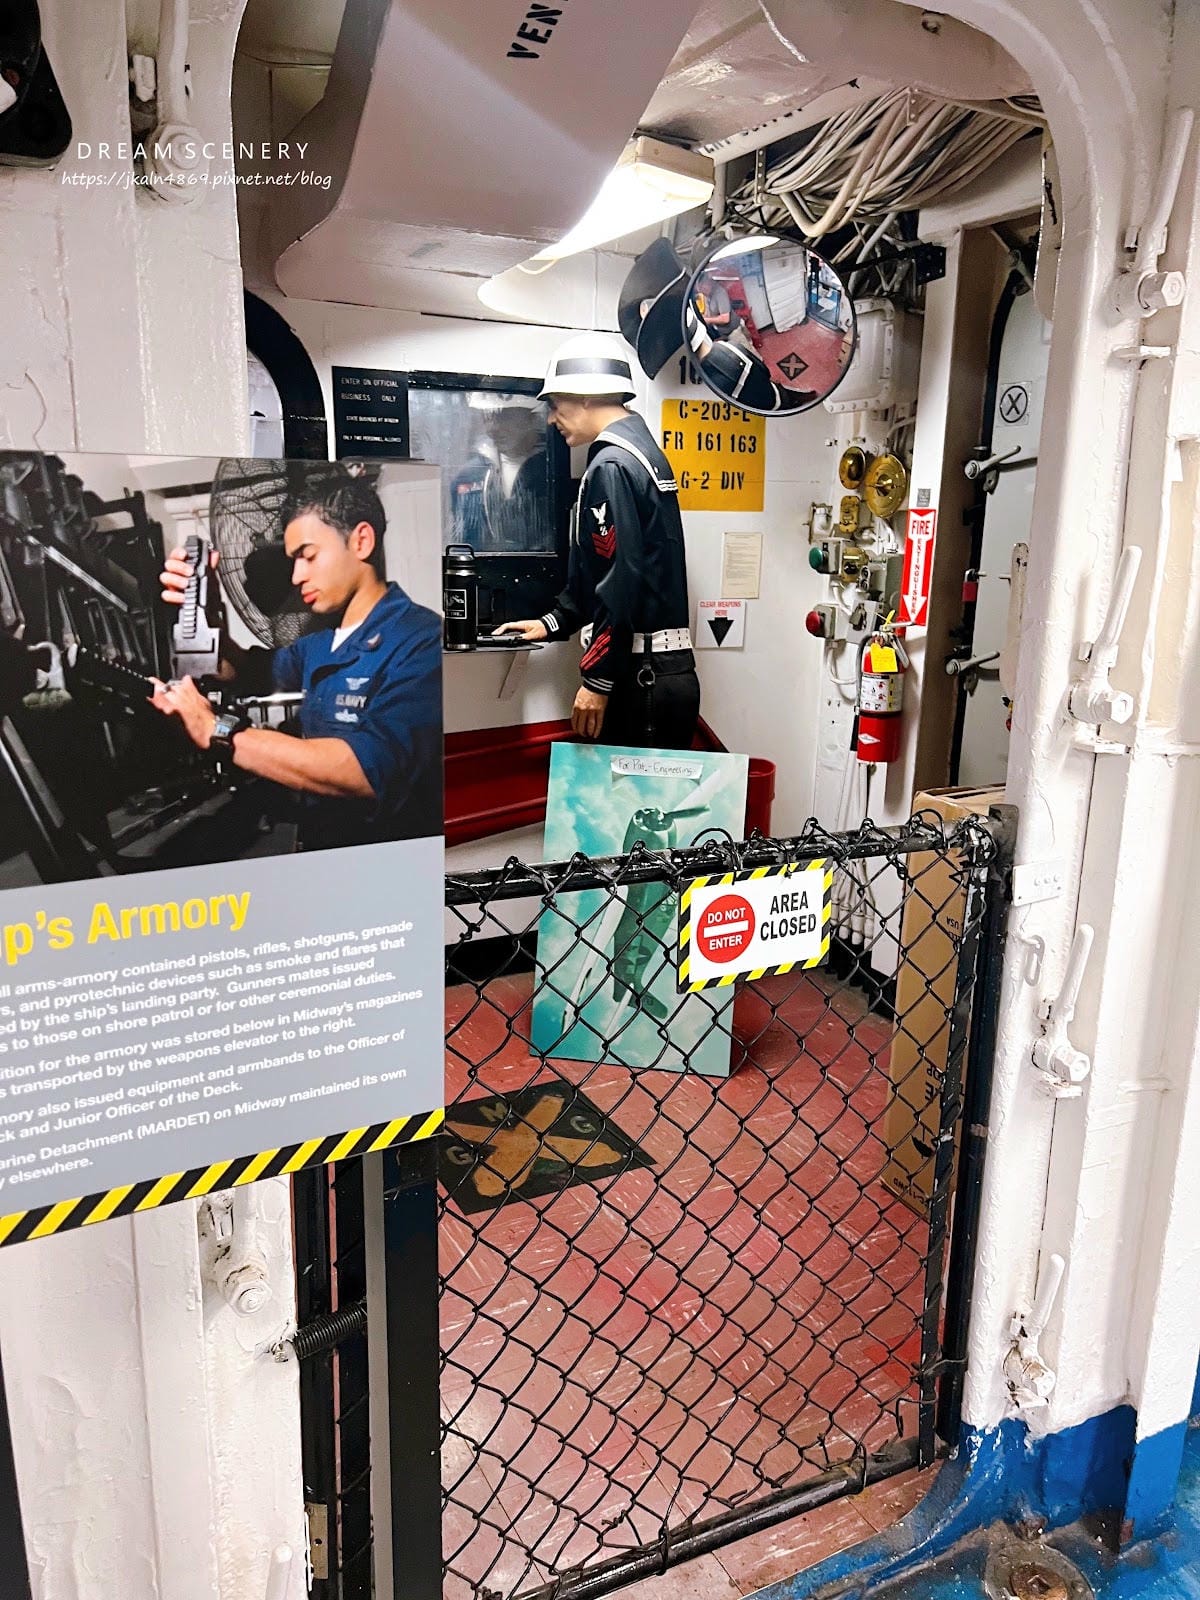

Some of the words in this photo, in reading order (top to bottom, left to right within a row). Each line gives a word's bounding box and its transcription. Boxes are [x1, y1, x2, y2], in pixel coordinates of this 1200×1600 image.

[506, 0, 569, 58] VEN
[663, 430, 684, 450] FR
[697, 431, 721, 452] 161
[730, 433, 757, 454] 163
[681, 471, 710, 490] G-2
[721, 471, 745, 490] DIV
[911, 520, 931, 536] FIRE
[0, 910, 74, 966] p's
[87, 891, 251, 945] Armory
[707, 911, 723, 924] DO
[725, 907, 747, 920] NOT
[760, 914, 817, 941] CLOSED
[770, 891, 809, 915] AREA
[0, 984, 11, 1000] ll
[15, 970, 118, 995] arms-armory
[122, 954, 196, 978] contained
[199, 947, 250, 967] pistols,
[253, 942, 290, 956] rifles,
[294, 930, 359, 949] shotguns,
[361, 920, 414, 940] grenade
[709, 935, 743, 951] ENTER
[19, 996, 50, 1013] and
[54, 982, 145, 1009] pyrotechnic
[148, 973, 205, 991] devices
[208, 965, 243, 981] such
[246, 962, 262, 974] as
[265, 954, 311, 971] smoke
[314, 948, 340, 962] and
[342, 943, 378, 957] flares
[380, 937, 406, 950] that
[21, 1017, 41, 1032] by
[44, 1013, 70, 1026] the
[74, 1003, 119, 1020] ship's
[122, 995, 176, 1012] landing
[180, 987, 220, 1005] party.
[227, 975, 286, 994] Gunners
[289, 967, 330, 983] mates
[332, 957, 375, 975] issued
[12, 1039, 29, 1051] to
[32, 1030, 78, 1047] those
[82, 1026, 101, 1038] on
[105, 1016, 148, 1033] shore
[151, 1006, 195, 1027] patrol
[197, 1004, 213, 1016] or
[216, 1000, 237, 1013] for
[239, 993, 276, 1008] other
[279, 977, 352, 1000] ceremonial
[354, 971, 396, 987] duties.
[39, 1059, 62, 1073] for
[65, 1053, 91, 1067] the
[94, 1042, 148, 1061] armory
[152, 1036, 182, 1049] was
[184, 1024, 231, 1044] stored
[233, 1018, 275, 1034] below
[278, 1014, 290, 1026] in
[293, 1001, 354, 1022] Midway's
[356, 989, 423, 1009] magazines
[10, 1066, 103, 1096] transported
[106, 1063, 126, 1077] by
[128, 1058, 153, 1072] the
[155, 1045, 221, 1067] weapons
[223, 1033, 280, 1053] elevator
[282, 1029, 296, 1041] to
[298, 1024, 320, 1037] the
[322, 1016, 356, 1033] right.
[37, 1103, 71, 1117] also
[74, 1087, 125, 1109] issued
[127, 1071, 205, 1098] equipment
[207, 1065, 234, 1081] and
[237, 1051, 305, 1074] armbands
[307, 1048, 321, 1059] to
[324, 1044, 345, 1056] the
[347, 1033, 390, 1051] Officer
[391, 1028, 406, 1042] of
[19, 1121, 50, 1139] and
[53, 1111, 103, 1131] Junior
[105, 1100, 157, 1119] Officer
[158, 1094, 174, 1107] of
[176, 1091, 200, 1104] the
[202, 1080, 243, 1098] Deck.
[39, 1129, 134, 1160] Detachment
[137, 1110, 210, 1139] (MARDET)
[213, 1108, 232, 1121] on
[234, 1095, 287, 1116] Midway
[289, 1076, 361, 1103] maintained
[362, 1073, 378, 1086] its
[380, 1067, 407, 1082] own
[570, 1115, 596, 1134] G
[8, 1156, 94, 1185] elsewhere.
